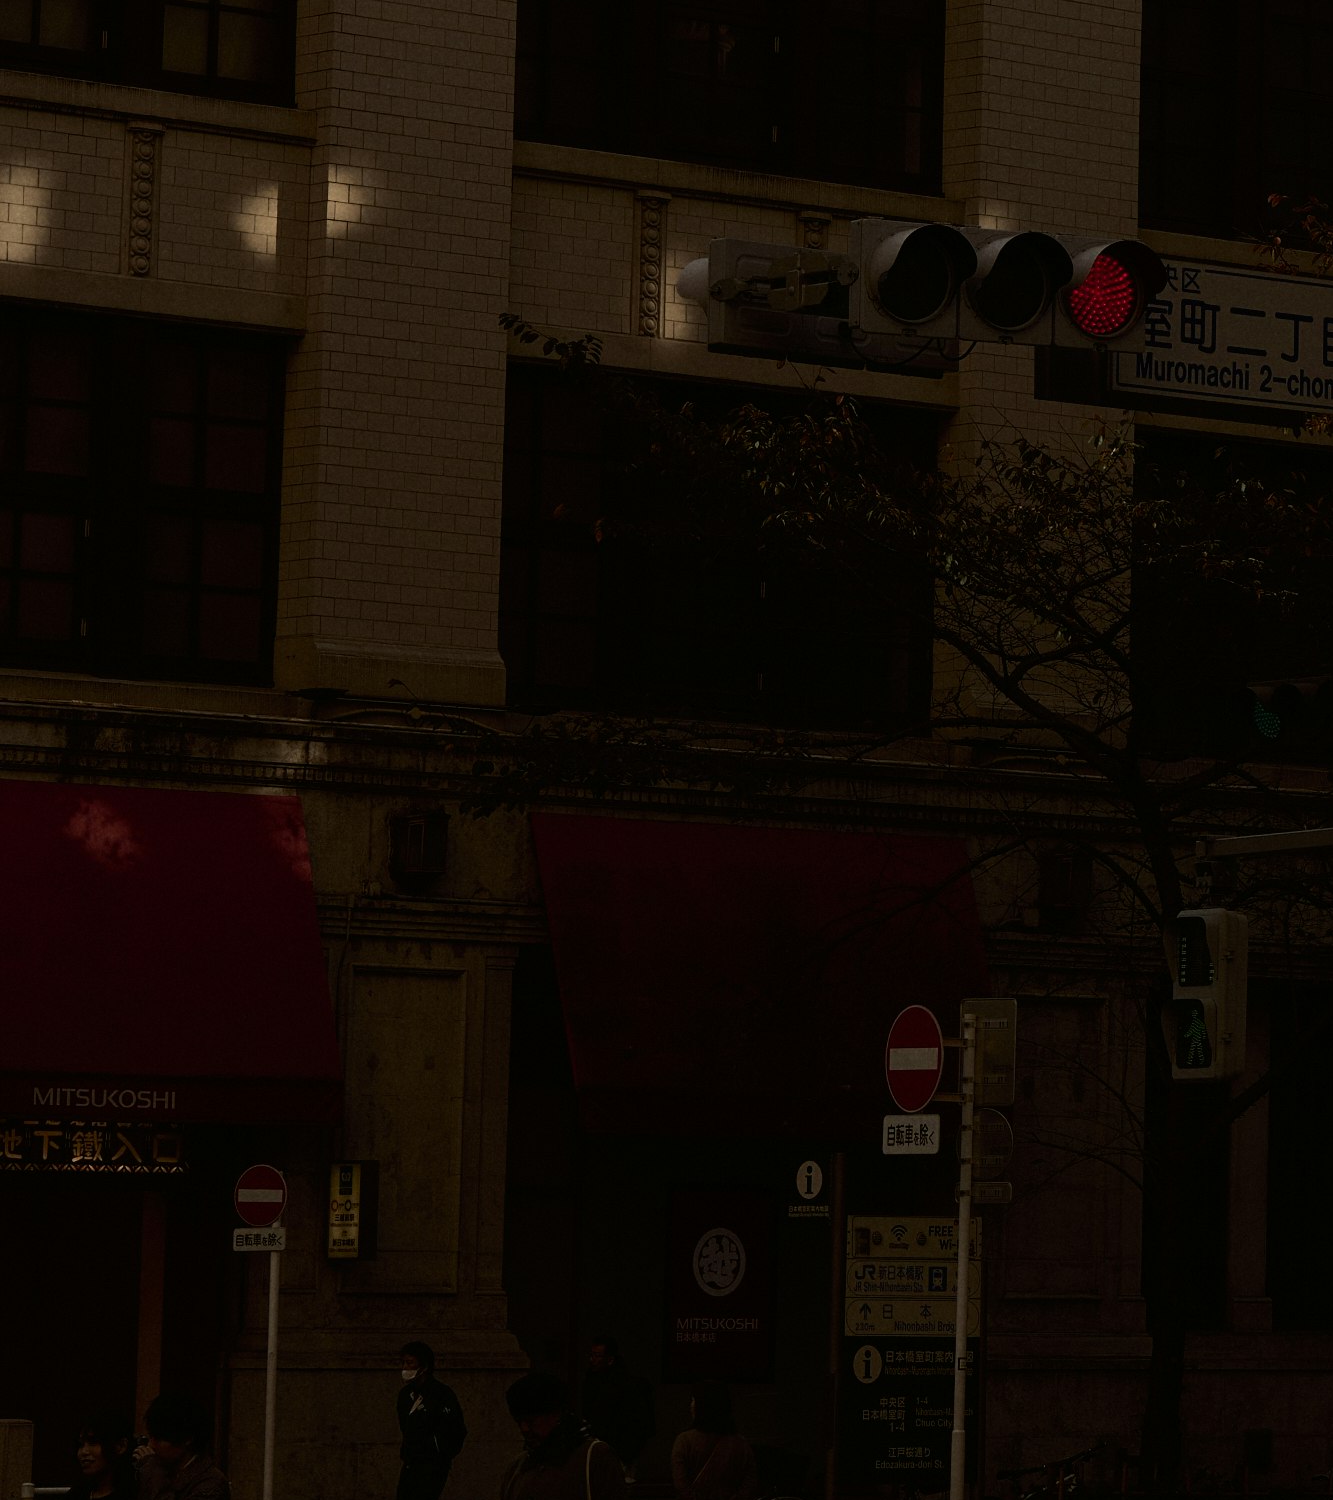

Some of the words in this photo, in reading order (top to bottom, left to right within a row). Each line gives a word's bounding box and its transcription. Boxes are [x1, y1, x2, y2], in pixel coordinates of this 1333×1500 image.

[1163, 263, 1201, 294] 央区
[1135, 352, 1250, 391] Muromachi
[33, 1087, 176, 1109] MITSUKOSHI
[886, 1123, 935, 1146] 自転車を除く
[928, 1225, 954, 1237] FREE
[235, 1232, 283, 1247] 自転車を除く
[939, 1239, 959, 1251] Wi-
[854, 1264, 876, 1281] JR
[879, 1265, 924, 1281] 新日本橋駅
[676, 1318, 759, 1330] MITSUKOSHI
[894, 1321, 936, 1331] Nihonbashi
[885, 1350, 975, 1364] 日本橋室町案内図
[879, 1396, 906, 1409] 中央区
[862, 1409, 906, 1421] 日本橋室町
[889, 1422, 906, 1433] 1-4
[915, 1418, 936, 1428] Chuo
[888, 1446, 931, 1459] 江戸桜通り
[875, 1459, 933, 1469] Edozakura-dori
